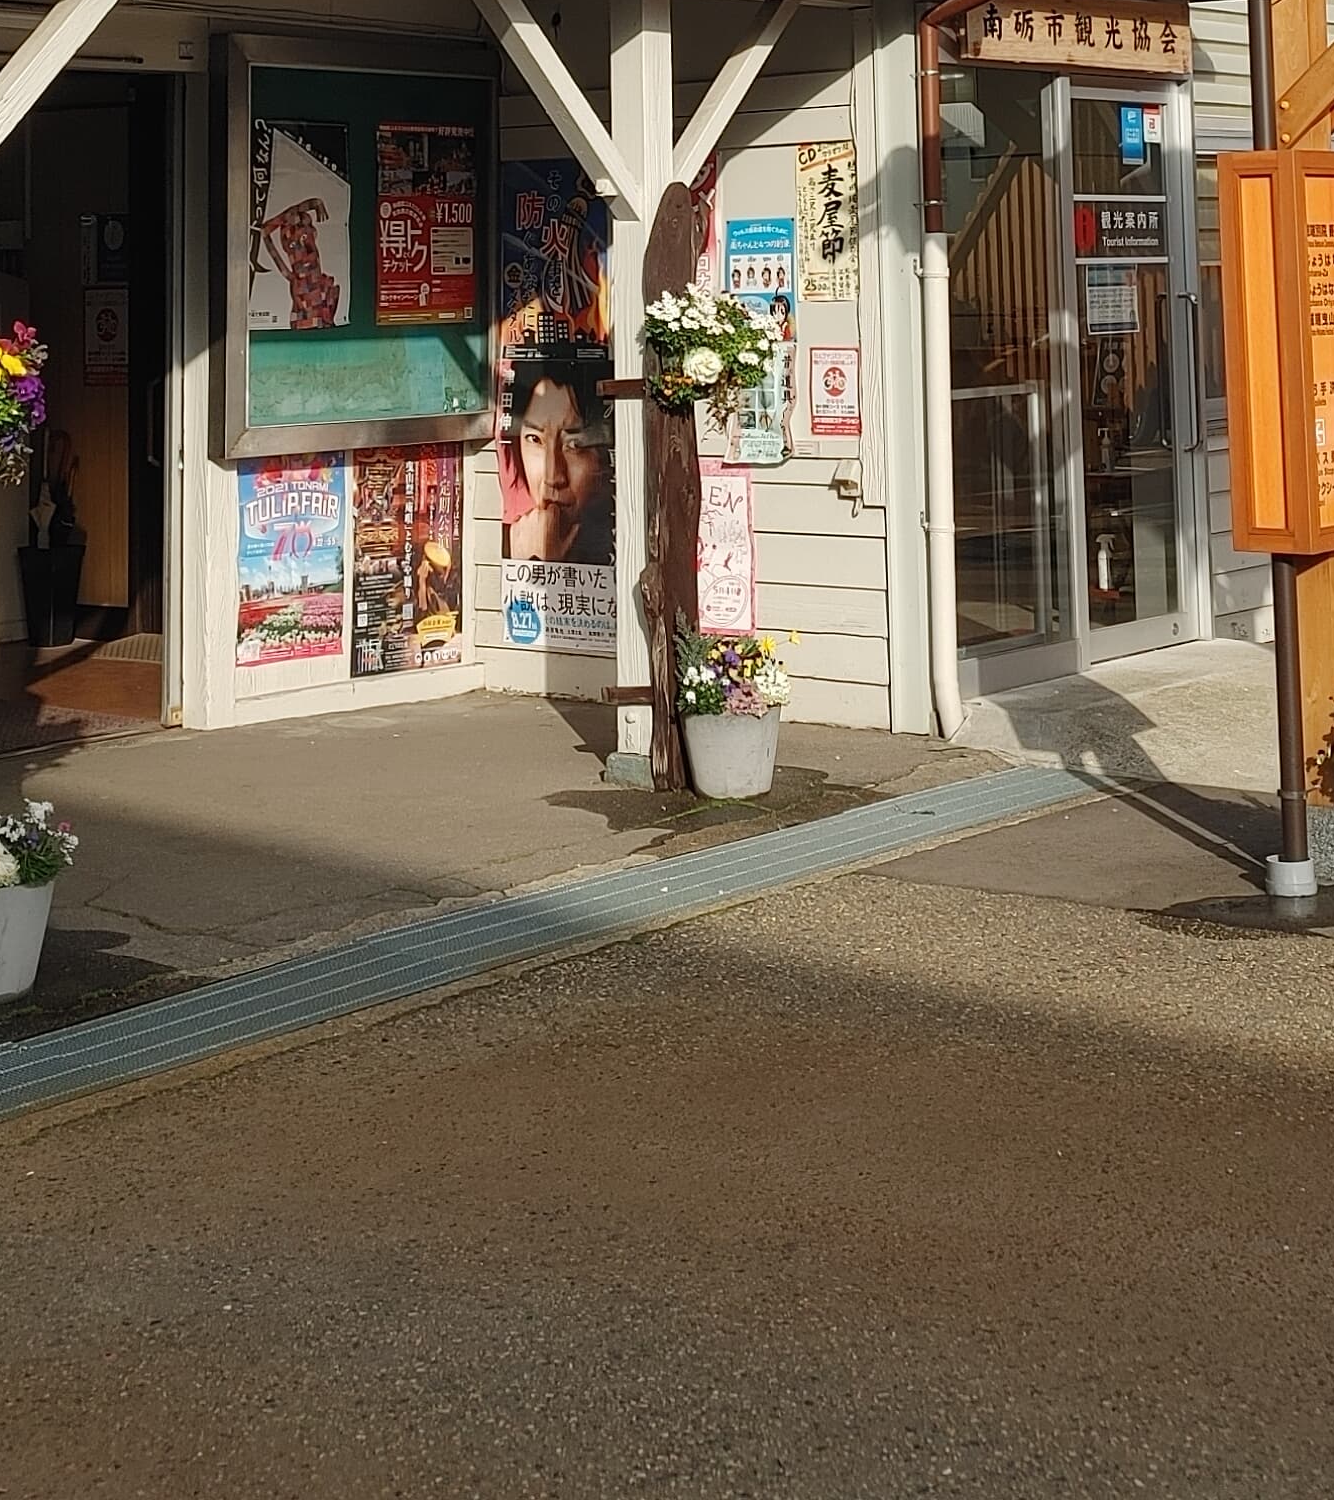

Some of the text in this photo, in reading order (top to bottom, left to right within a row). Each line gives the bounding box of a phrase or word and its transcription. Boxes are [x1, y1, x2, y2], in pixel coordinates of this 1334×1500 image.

[982, 2, 1179, 55] 南砺市観光協会
[798, 147, 817, 165] CD
[817, 163, 845, 265] 麦屋節
[1100, 211, 1159, 230] 観光案内所
[1102, 236, 1125, 247] Tourist
[256, 481, 330, 499] 2021 TONAMI
